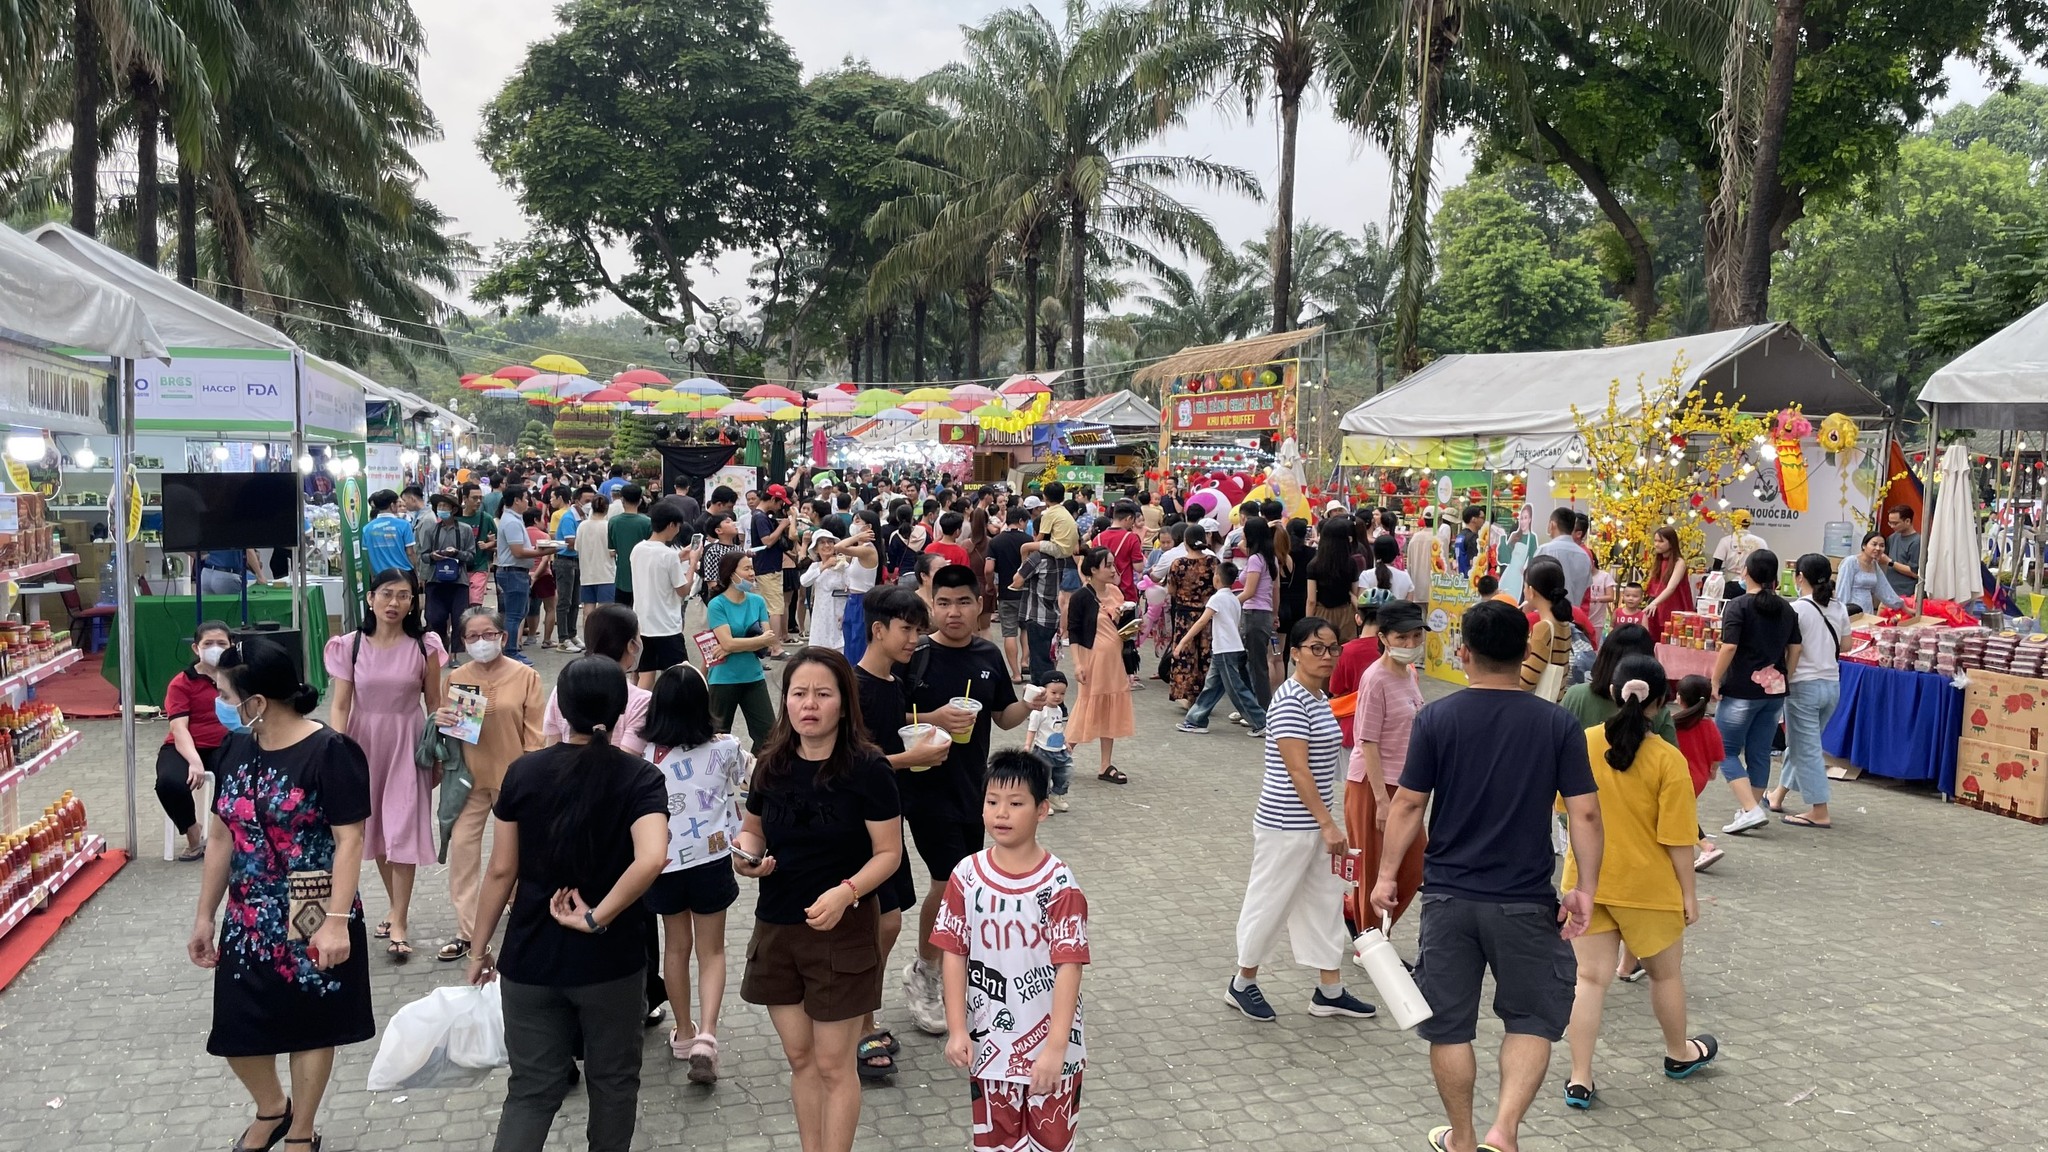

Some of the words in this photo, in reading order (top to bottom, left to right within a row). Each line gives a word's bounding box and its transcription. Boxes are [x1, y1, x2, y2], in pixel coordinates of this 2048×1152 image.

[28, 366, 70, 414] CHOLIMEX
[71, 377, 89, 417] FOOD
[202, 385, 237, 393] HACCP
[247, 383, 279, 396] FDA
[1207, 415, 1220, 426] KHU
[1232, 414, 1256, 425] BUFFET
[670, 757, 694, 781] U
[680, 817, 709, 839] X
[678, 845, 696, 865] E
